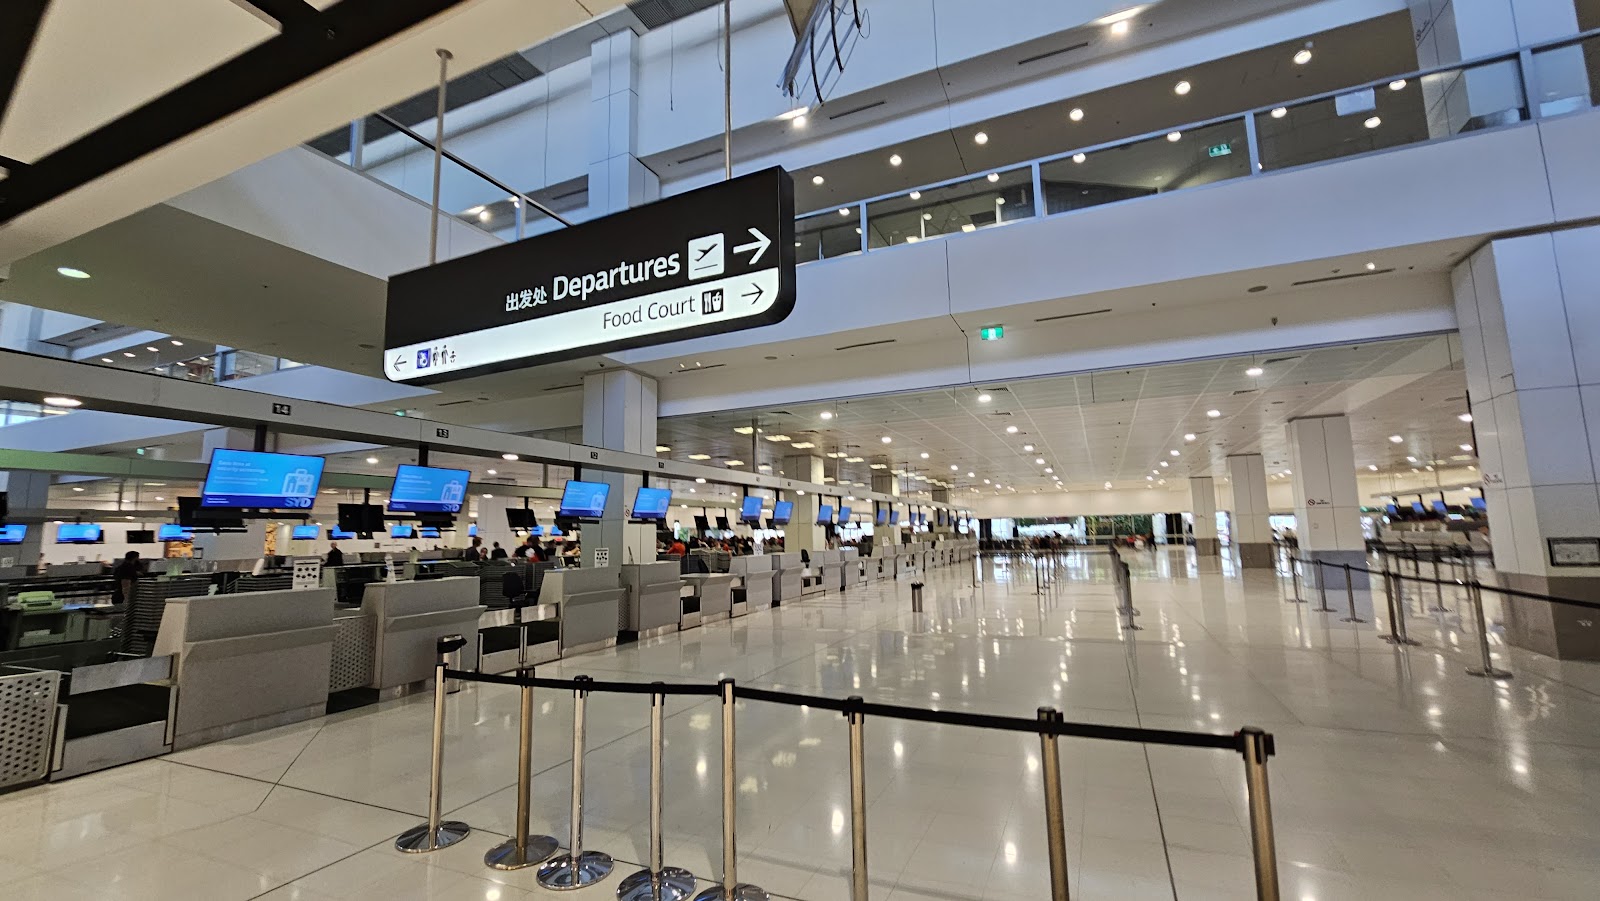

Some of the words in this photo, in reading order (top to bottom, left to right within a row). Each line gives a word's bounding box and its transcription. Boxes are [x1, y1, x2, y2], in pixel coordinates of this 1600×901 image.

[553, 252, 681, 300] Departures
[505, 286, 547, 312] 出发处
[603, 304, 643, 330] Food
[647, 295, 696, 321] Court
[274, 404, 290, 415] 14
[285, 497, 312, 508] SYD
